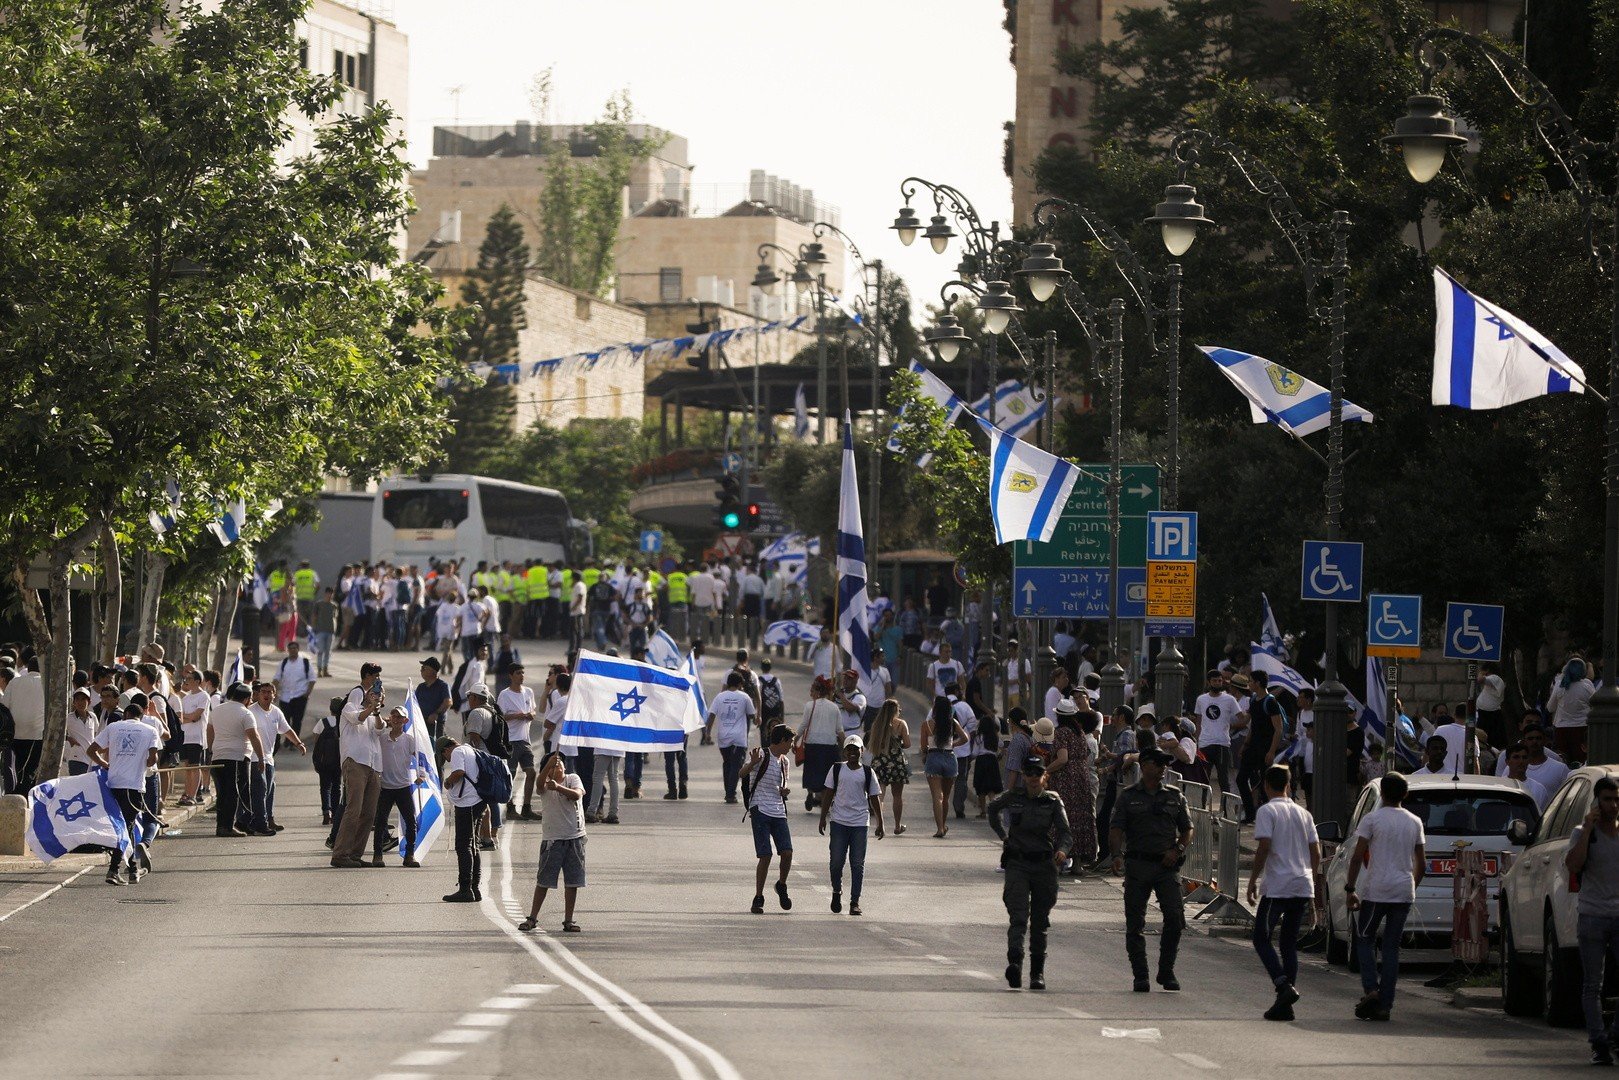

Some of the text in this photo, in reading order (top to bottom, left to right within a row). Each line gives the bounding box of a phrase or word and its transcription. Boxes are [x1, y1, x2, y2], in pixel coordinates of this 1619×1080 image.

[1059, 573, 1089, 583] אביב
[1061, 601, 1079, 611] Tel
[1167, 605, 1174, 615] 3
